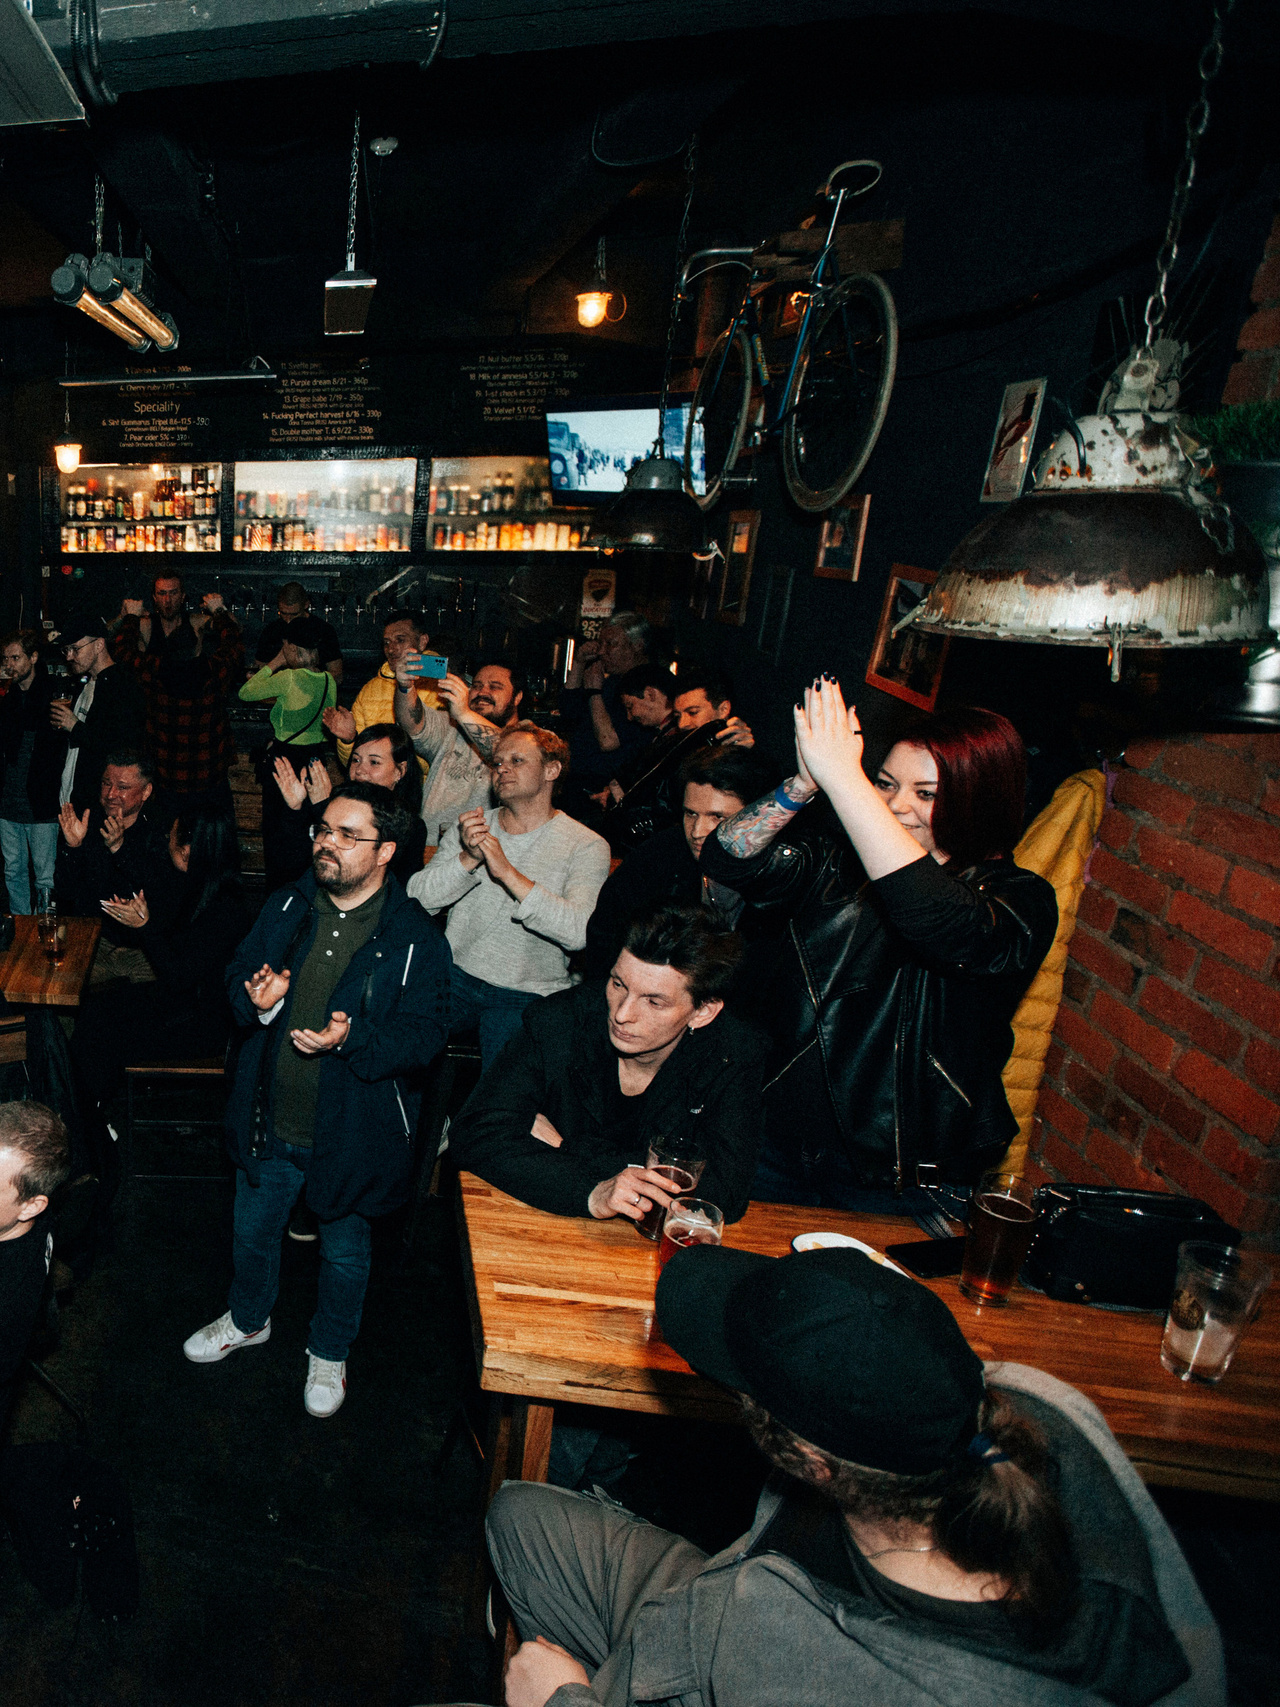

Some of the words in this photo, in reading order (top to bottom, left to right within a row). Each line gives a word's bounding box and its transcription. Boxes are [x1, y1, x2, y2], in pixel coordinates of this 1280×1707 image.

[290, 379, 310, 387] Purple
[134, 401, 180, 415] Speciality
[271, 412, 294, 421] Fucking
[366, 410, 382, 420] 330p
[358, 426, 373, 435] 330p
